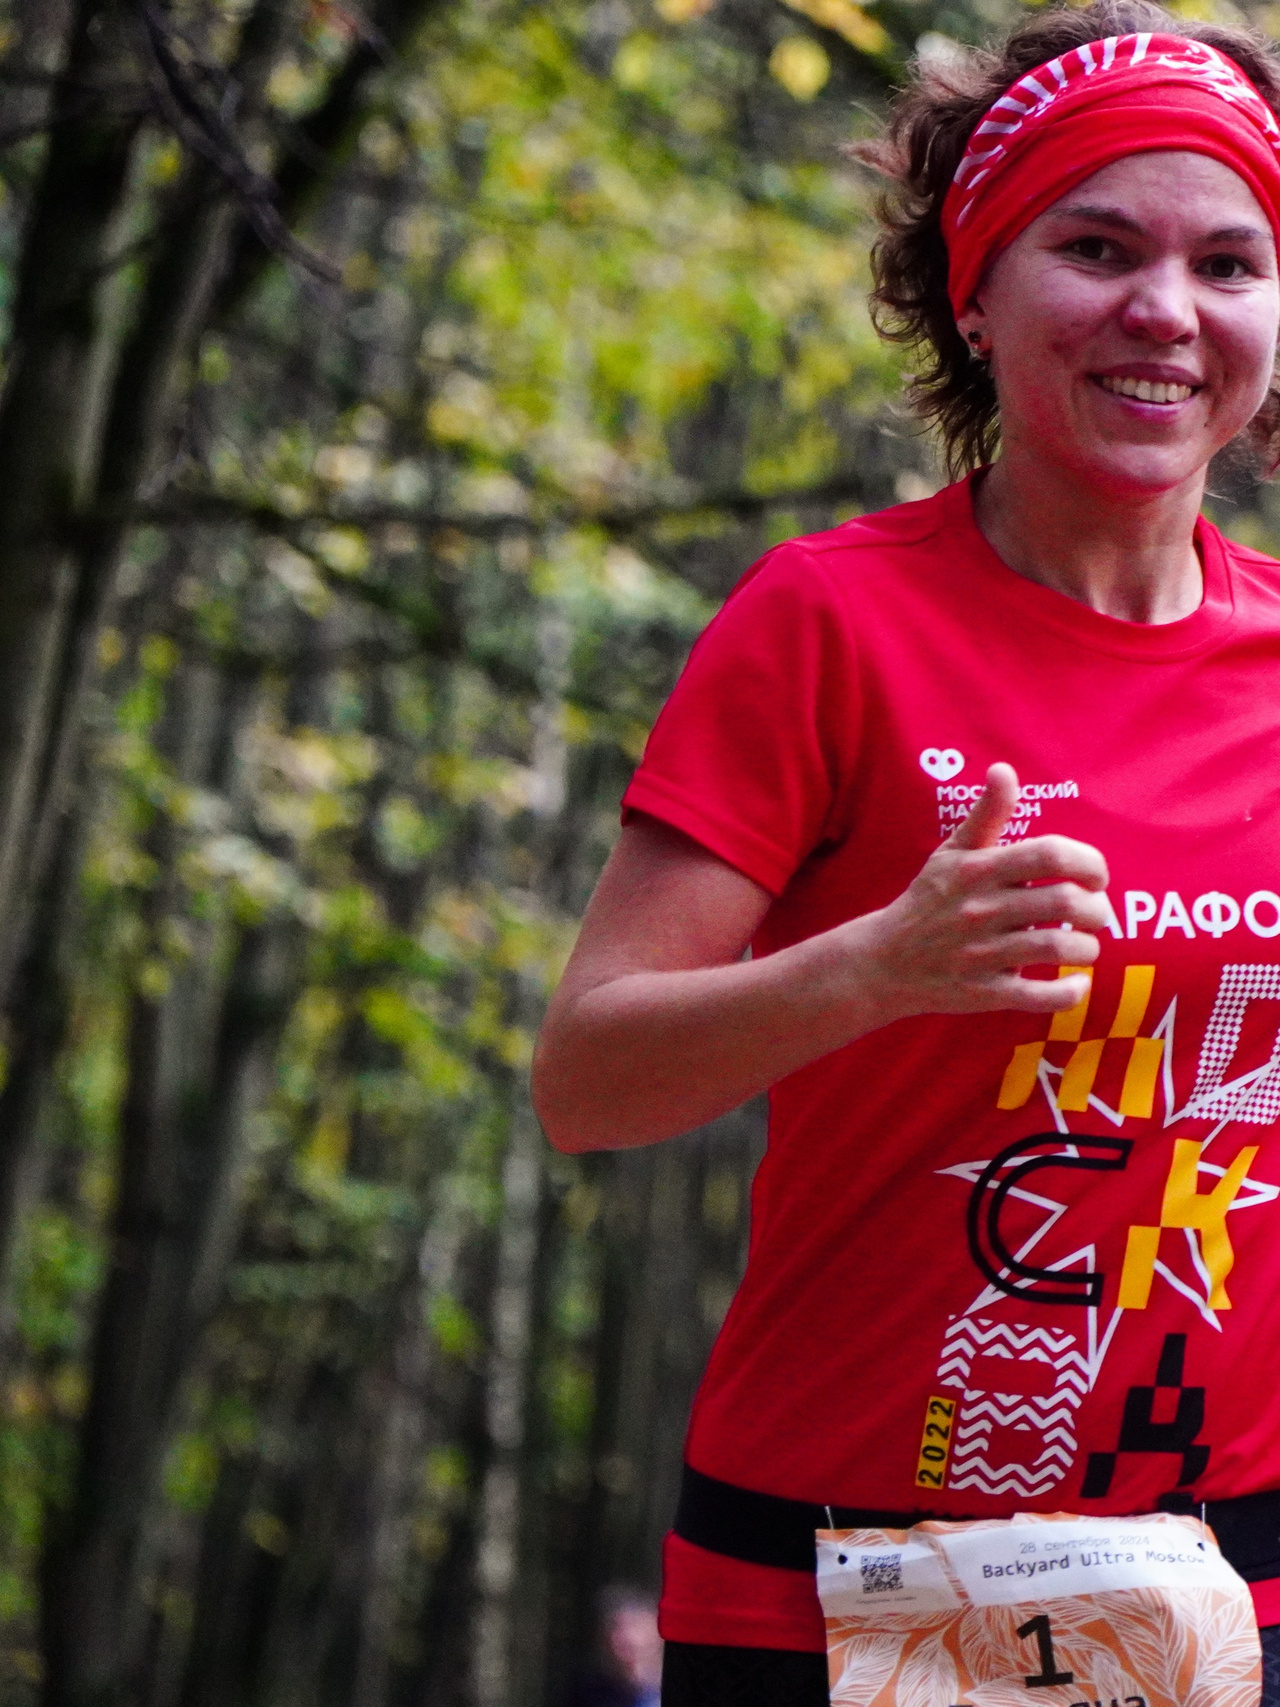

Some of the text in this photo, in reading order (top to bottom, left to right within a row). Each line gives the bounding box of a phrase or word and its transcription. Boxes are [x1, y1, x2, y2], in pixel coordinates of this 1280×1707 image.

[936, 780, 1079, 802] МОССКИЙ
[938, 802, 1042, 820] МАОН
[918, 1400, 954, 1486] 2022
[1020, 1535, 1150, 1554] 28 сентября 2024
[982, 1554, 1070, 1579] Backyard
[1081, 1550, 1135, 1566] Ultra
[1016, 1614, 1073, 1688] 1
